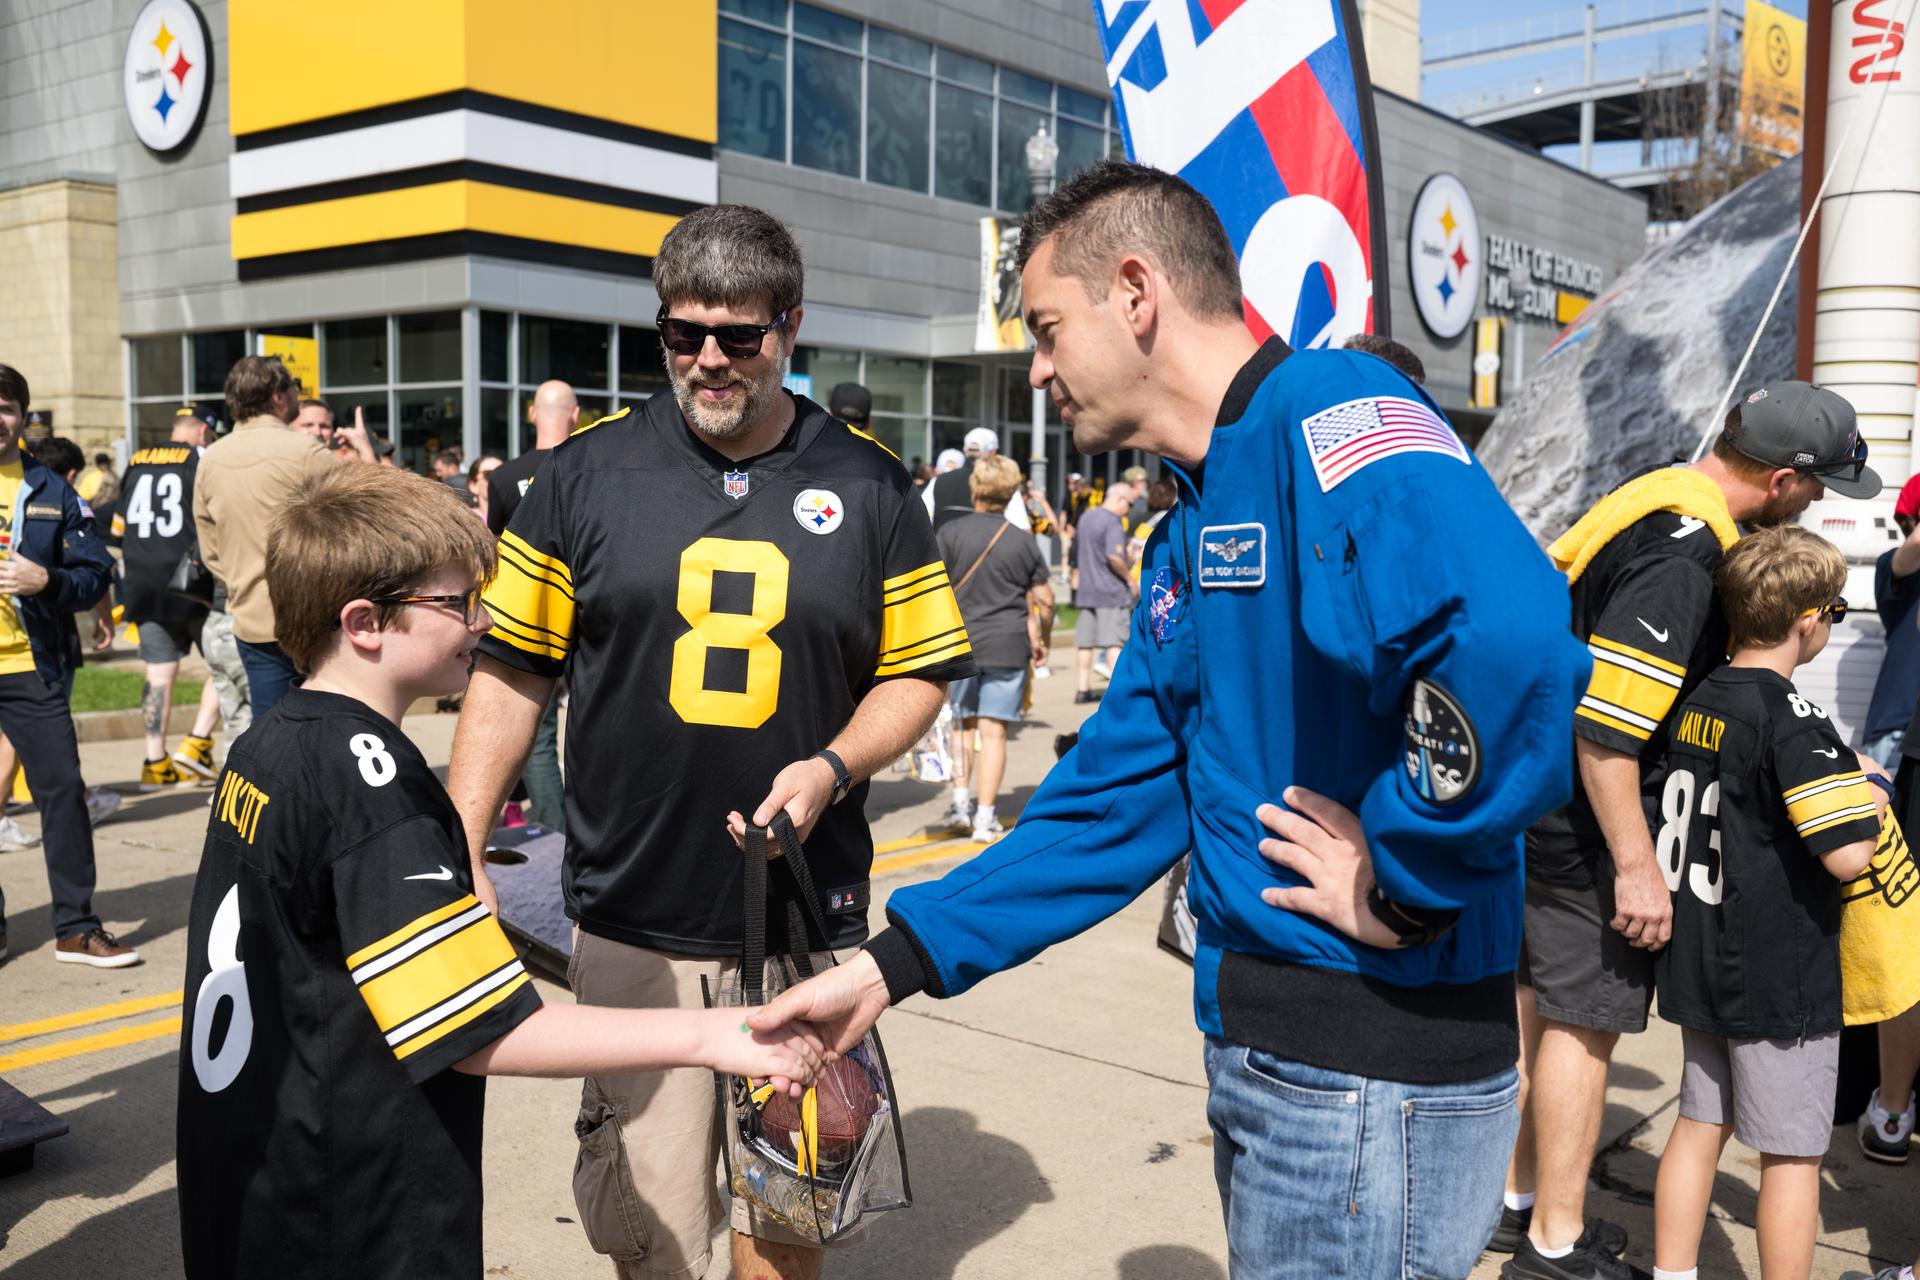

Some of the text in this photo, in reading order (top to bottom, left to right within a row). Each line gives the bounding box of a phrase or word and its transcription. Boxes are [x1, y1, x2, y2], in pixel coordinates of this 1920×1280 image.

[1489, 234, 1602, 292] HALL OF HONOR
[727, 481, 745, 493] NFL
[1794, 456, 1814, 464] CATCH
[126, 473, 184, 538] 43
[668, 537, 790, 729] 8
[349, 733, 397, 787] 8
[1656, 769, 1723, 905] 83
